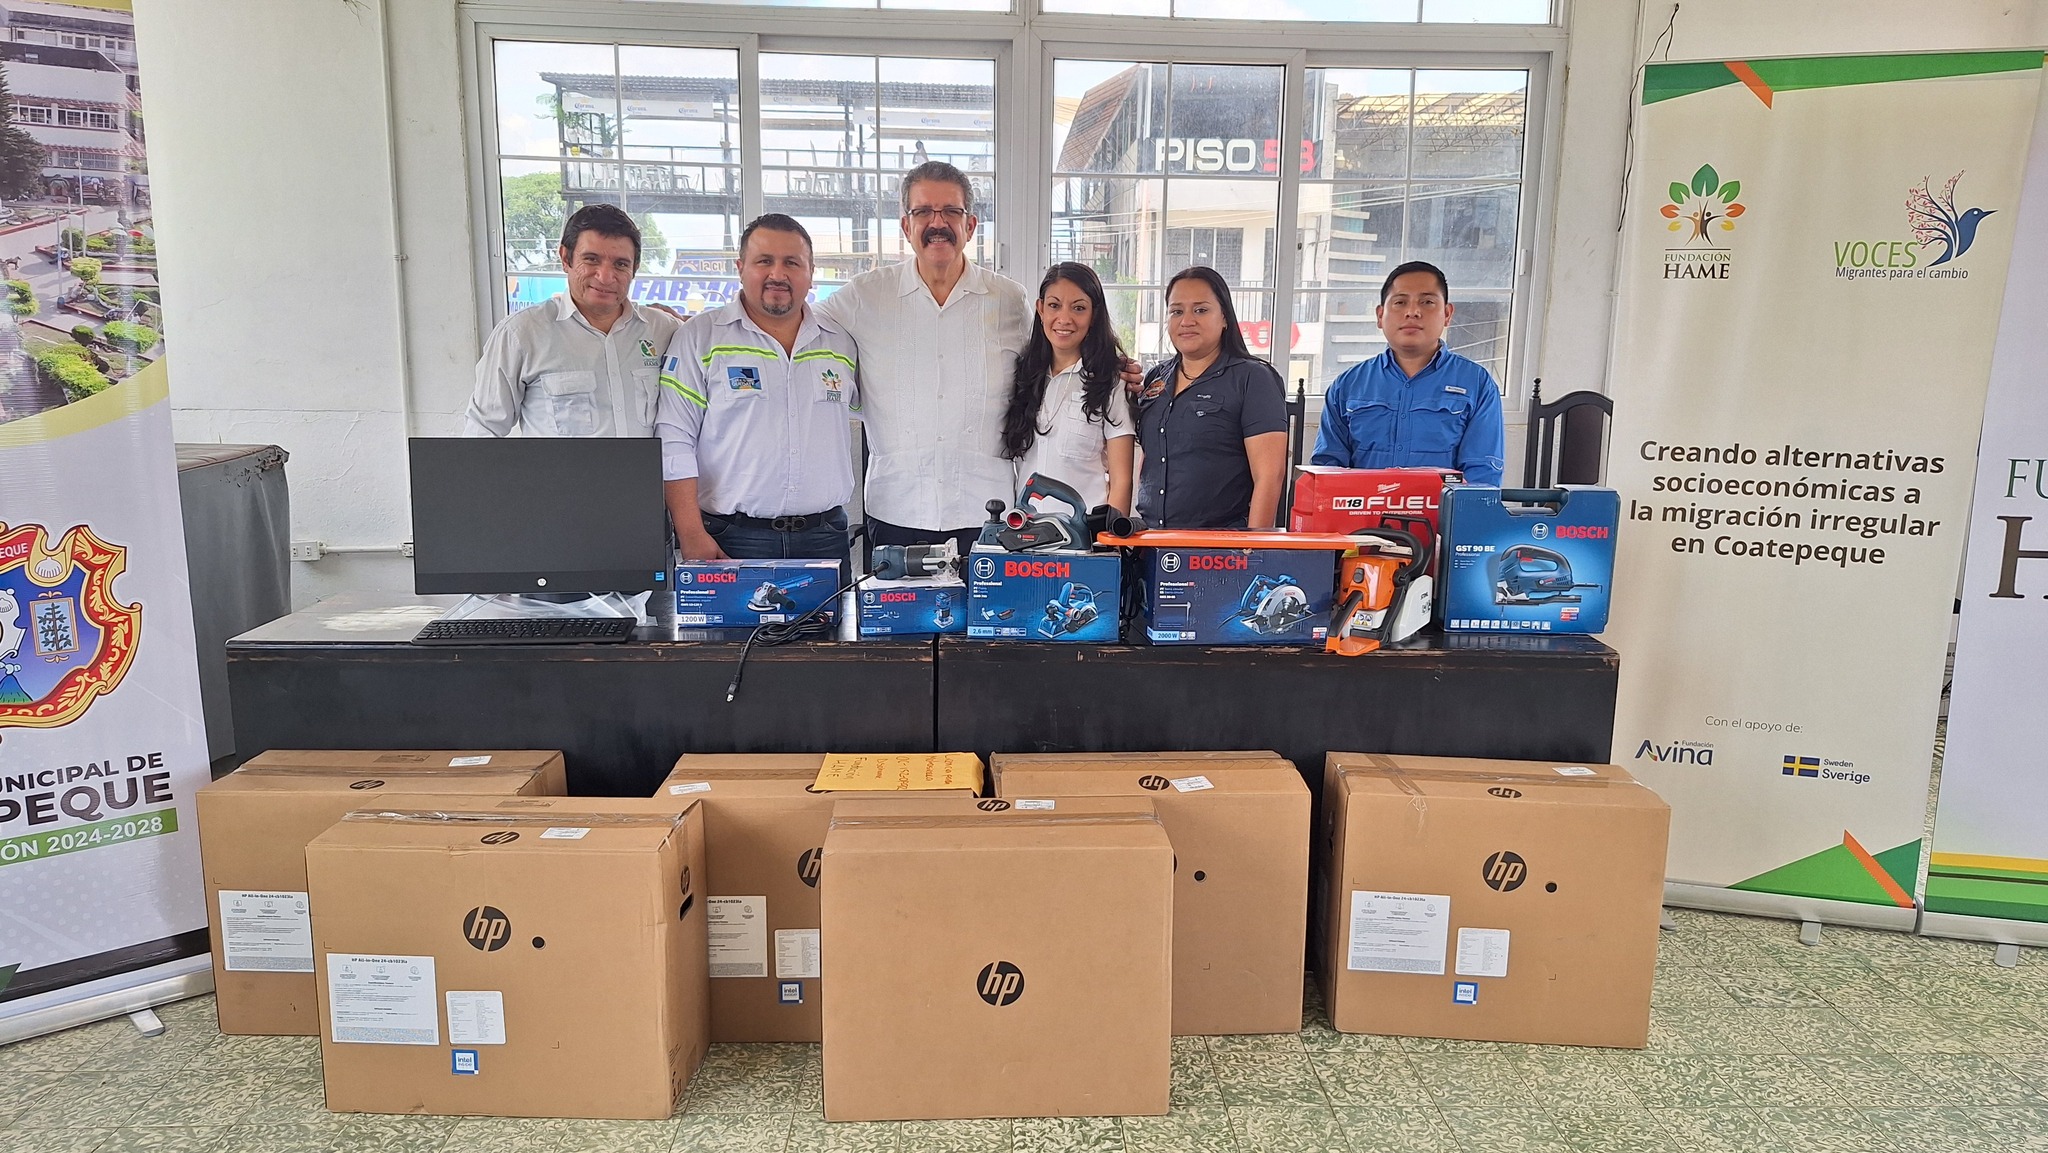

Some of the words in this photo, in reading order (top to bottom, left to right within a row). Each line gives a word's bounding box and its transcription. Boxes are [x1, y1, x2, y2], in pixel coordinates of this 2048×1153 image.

[1155, 138, 1256, 171] PISO
[1664, 250, 1731, 262] FUNDACIÓN
[1834, 241, 1918, 268] VOCES
[1663, 263, 1730, 280] HAME
[1835, 266, 1886, 280] Migrantes
[1889, 270, 1913, 281] para
[1916, 267, 1926, 278] el
[1929, 267, 1968, 279] cambio
[1640, 440, 1757, 465] Creando
[1765, 444, 1945, 474] alternativas
[1652, 472, 1895, 503] socioeconómicas
[1904, 487, 1921, 504] a
[1334, 498, 1362, 508] M18
[1366, 495, 1439, 509] FUEL
[1630, 500, 1653, 521] la
[1661, 500, 1801, 530] migración
[1811, 508, 1940, 539] irregular
[1556, 526, 1608, 538] BOSCH
[1671, 536, 1704, 554] en
[1714, 535, 1885, 568] Coatepeque
[1004, 561, 1070, 578] BOSCH
[1189, 555, 1248, 570] BOSCH
[697, 573, 737, 583] BOSCH
[880, 592, 916, 603] BOSCH
[1705, 716, 1728, 727] Con
[1732, 718, 1741, 728] el
[1745, 721, 1782, 733] apoyo
[1785, 722, 1803, 733] de:
[1635, 739, 1713, 766] Avina
[1681, 740, 1714, 748] Fundación
[1823, 758, 1854, 768] Sweden
[0, 760, 119, 793] NICIPAL
[127, 752, 163, 772] DE
[1822, 768, 1871, 785] Sverige
[979, 800, 1008, 811] hp
[47, 817, 163, 853] 2024-2028
[1485, 851, 1526, 892] hp
[466, 906, 509, 952] hp
[979, 961, 1022, 1006] hp
[1459, 987, 1473, 995] intel
